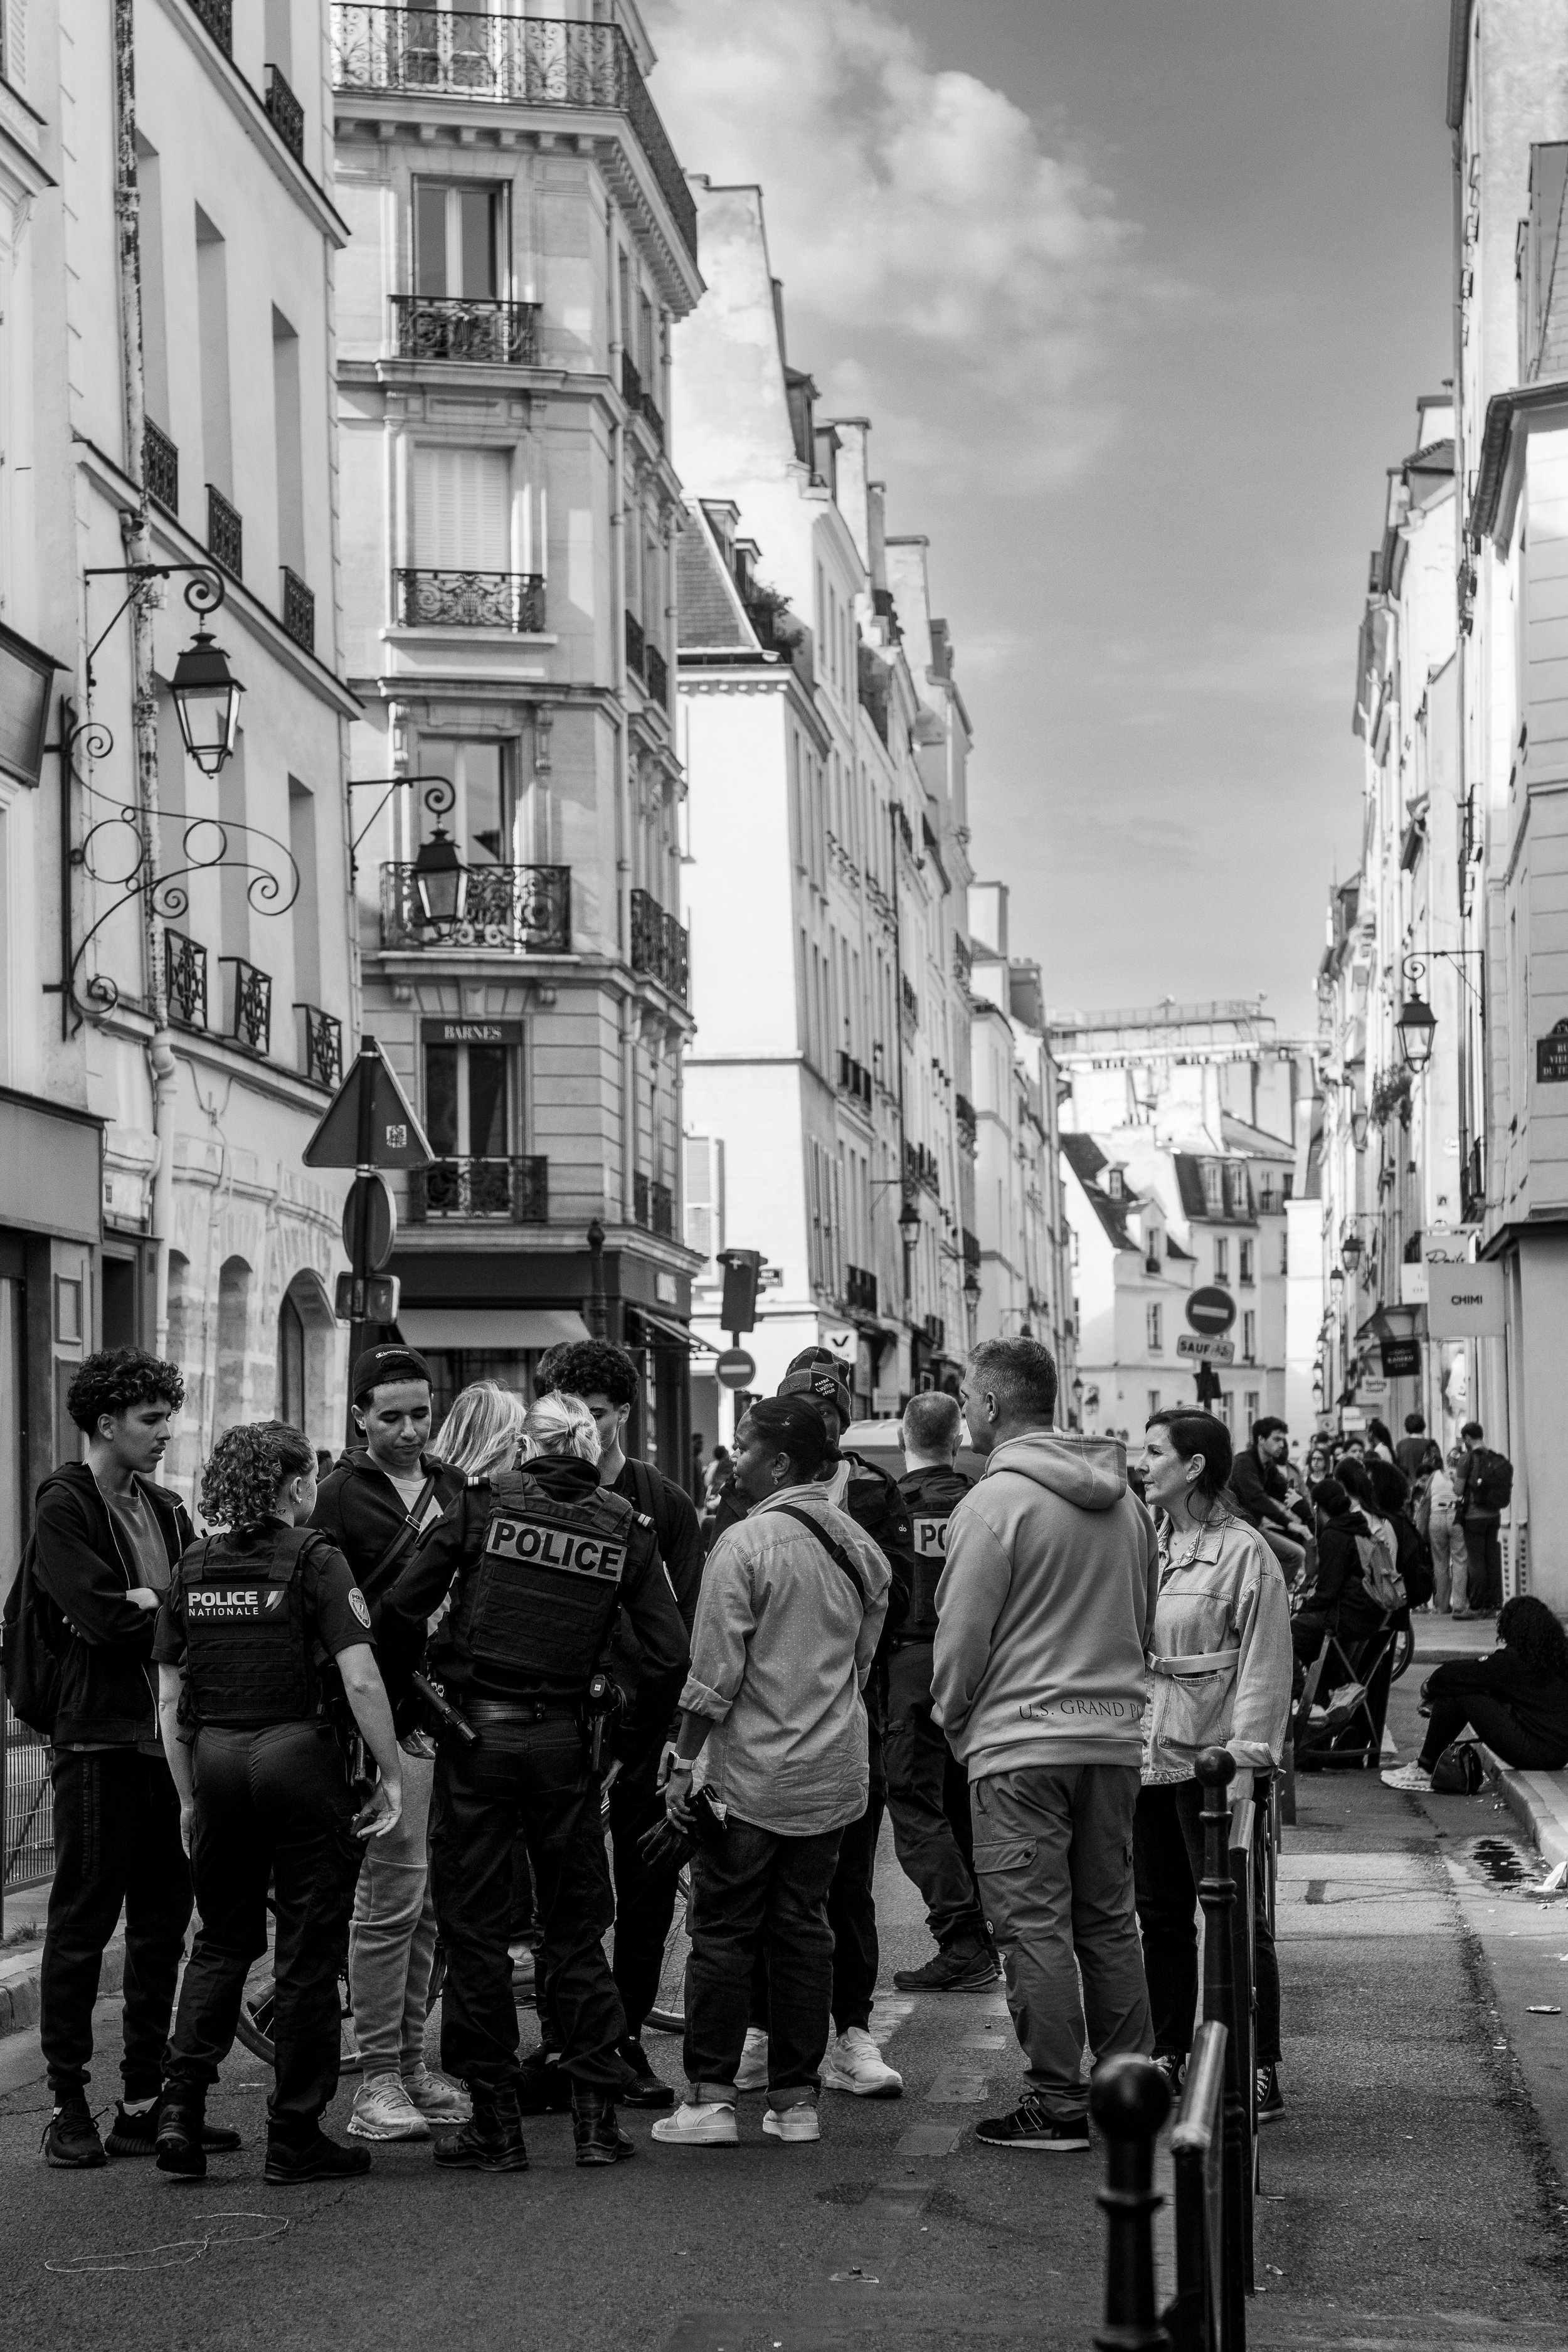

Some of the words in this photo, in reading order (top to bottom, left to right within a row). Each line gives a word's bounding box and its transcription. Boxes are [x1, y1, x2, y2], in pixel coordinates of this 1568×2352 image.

[445, 1025, 502, 1040] BARNES
[1451, 1295, 1483, 1306] CHIMI
[1180, 1340, 1210, 1355] SAUF
[491, 1522, 622, 1577] POLICE
[188, 1591, 258, 1606] POLICE
[189, 1607, 259, 1616] NATIONALE
[1019, 1702, 1054, 1720] U.S.
[1060, 1700, 1125, 1717] GRAND
